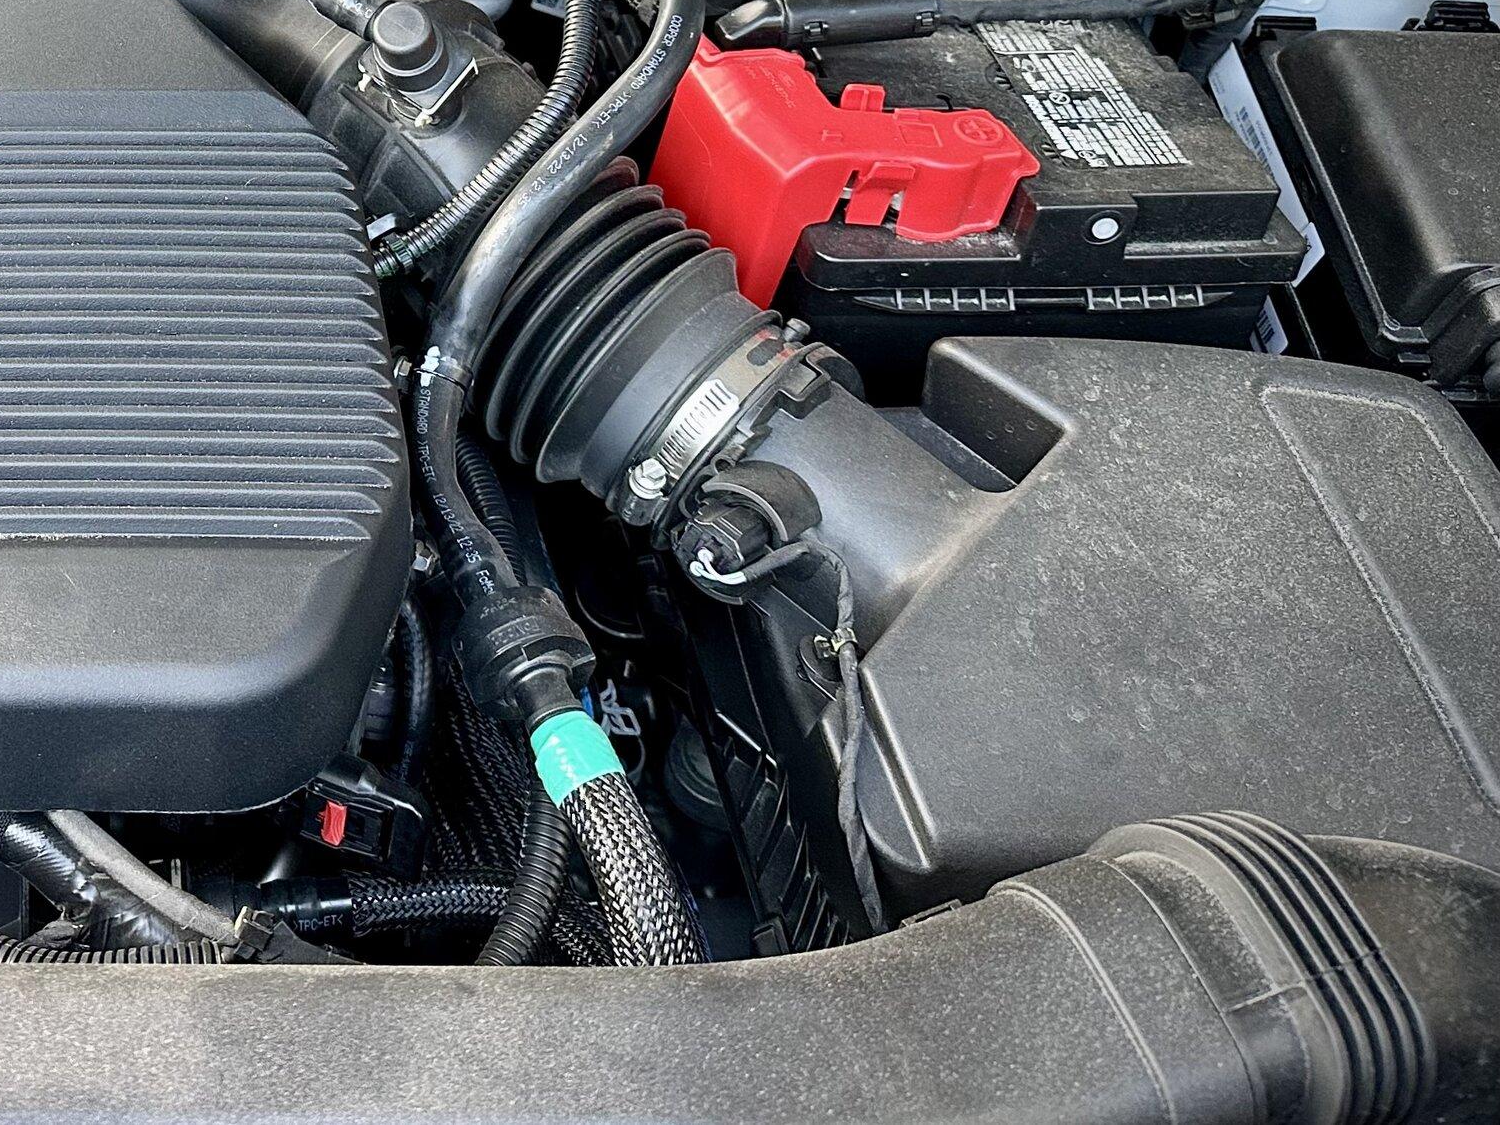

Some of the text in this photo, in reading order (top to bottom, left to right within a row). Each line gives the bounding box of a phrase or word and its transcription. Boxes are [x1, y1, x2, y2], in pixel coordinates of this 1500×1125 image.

[661, 14, 683, 47] COOPER
[630, 48, 667, 90] STANDARD
[548, 133, 588, 174] 12/13/22
[517, 177, 546, 206] 12:35
[417, 388, 431, 435] STANDARD
[433, 492, 464, 535] 12/13/22
[456, 535, 482, 564] 12:35
